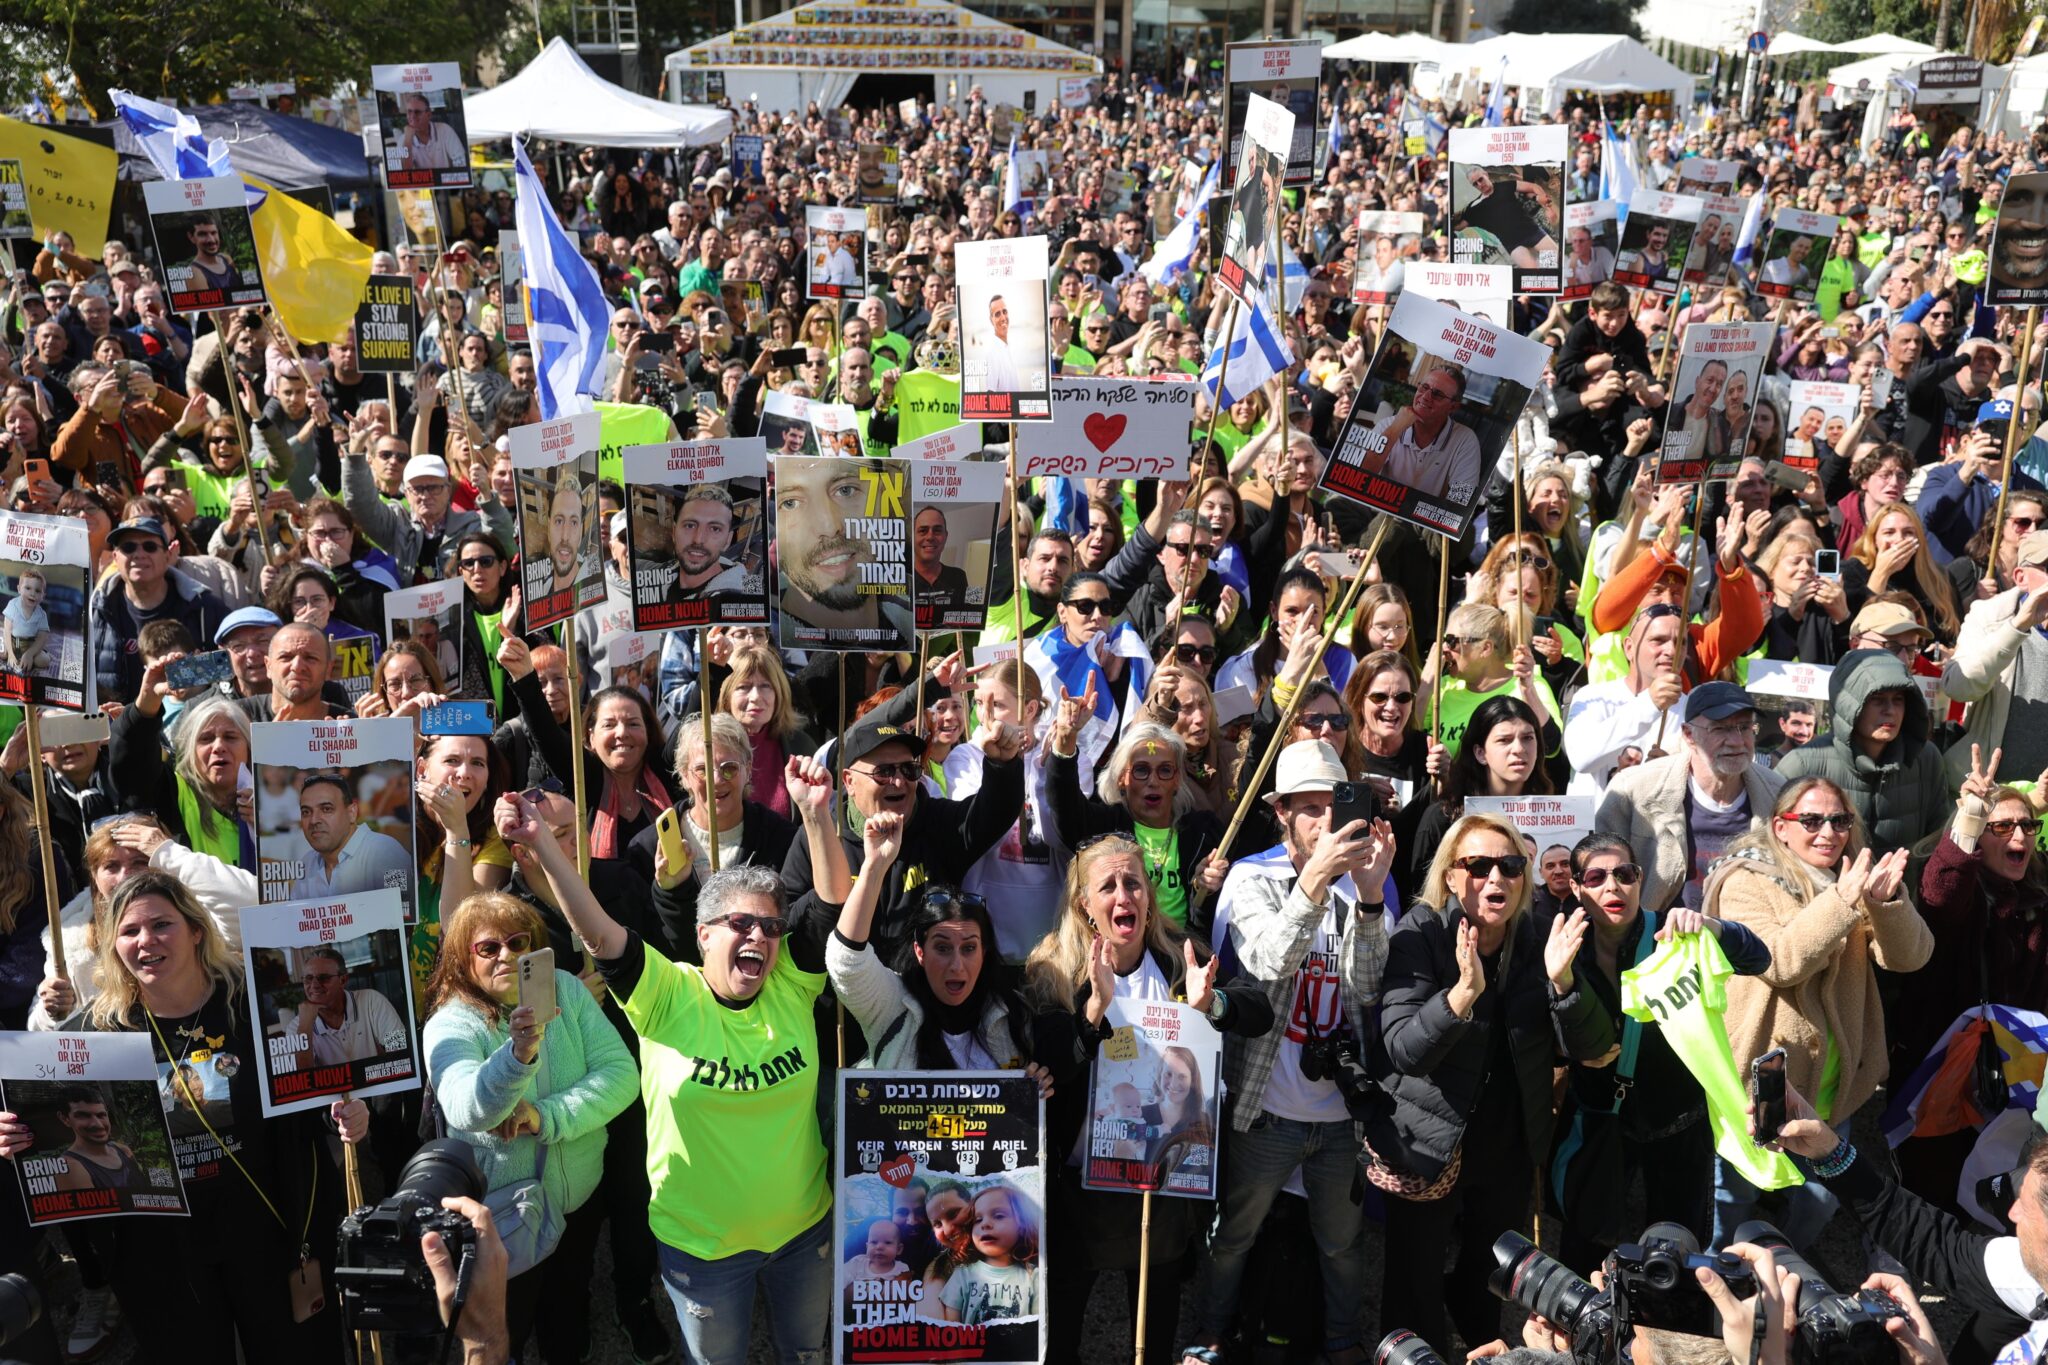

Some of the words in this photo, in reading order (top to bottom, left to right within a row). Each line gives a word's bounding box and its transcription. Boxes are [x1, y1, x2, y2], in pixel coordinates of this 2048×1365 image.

[1277, 58, 1291, 67] BIBAS
[1491, 133, 1502, 142] עמי
[1503, 134, 1510, 143] בן
[1487, 143, 1503, 153] OHAD
[1501, 153, 1514, 163] (55)
[1453, 237, 1484, 254] BRING
[1453, 253, 1473, 264] HIM
[167, 267, 193, 280] BRING
[1476, 272, 1490, 286] אלי
[173, 291, 198, 306] HOME
[373, 286, 405, 304] LOVE
[404, 288, 411, 305] U
[371, 304, 399, 322] STAY
[362, 322, 409, 341] STRONG!
[1467, 322, 1476, 337] בן
[1476, 325, 1498, 345] אוהד
[362, 340, 411, 359] SURVIVE!
[1441, 329, 1465, 349] OHAD
[1464, 335, 1481, 352] BEN
[1479, 342, 1497, 359] AMI
[1695, 341, 1703, 352] ELI
[1453, 347, 1472, 364] (55)
[964, 394, 988, 411] HOME
[989, 392, 1012, 411] NOW!
[1052, 387, 1091, 402] הרבה
[1096, 384, 1138, 407] שלקח
[1145, 387, 1188, 404] סליחה
[910, 398, 925, 413] לבד
[927, 398, 940, 413] לא
[1347, 426, 1388, 454] BRING
[1664, 431, 1692, 446] BRING
[671, 447, 696, 459] בוחבוט
[697, 445, 720, 458] אלקנה
[1337, 443, 1366, 468] HIM
[1664, 446, 1687, 461] THEM
[667, 456, 696, 471] ELKANA
[697, 456, 725, 469] BOHBOT
[1026, 455, 1088, 475] השבים
[1098, 455, 1175, 475] ברוכים
[1685, 459, 1707, 475] NOW!
[689, 470, 705, 482] (34)
[922, 476, 945, 487] TSACHI
[945, 476, 962, 487] IDAN
[860, 466, 905, 518] אל
[923, 487, 943, 499] (50)
[1329, 464, 1370, 491] HOME
[1369, 478, 1408, 508] NOW!
[8, 523, 26, 536] ביבס
[844, 518, 906, 541] תשאירו
[1439, 515, 1461, 530] FORUM
[27, 526, 46, 539] אריאל
[6, 534, 25, 548] ARIEL
[25, 537, 46, 550] BIBAS
[871, 540, 906, 563] אותי
[526, 557, 551, 582] BRING
[857, 562, 906, 584] מאחור
[636, 569, 673, 588] BRING
[527, 581, 544, 602] HIM
[637, 587, 661, 605] HIM
[856, 584, 882, 596] בוחבוט
[528, 595, 551, 622] HOME
[551, 588, 576, 612] NOW!
[638, 602, 672, 623] HOME
[675, 598, 710, 618] NOW!
[916, 604, 934, 623] W!
[335, 644, 370, 678] אל
[311, 726, 338, 738] שרעבי
[340, 725, 353, 738] אלי
[308, 740, 321, 752] ELI
[322, 738, 358, 752] SHARABI
[326, 752, 342, 766] (51)
[1501, 802, 1527, 813] שרעבי
[1528, 801, 1547, 813] ויוסי
[1548, 801, 1562, 812] אלי
[1516, 815, 1539, 826] YOSSI
[1540, 814, 1576, 826] SHARABI
[262, 860, 306, 882] BRING
[262, 881, 291, 902] HIM
[302, 907, 318, 920] עמי
[328, 903, 348, 917] אוהד
[298, 918, 321, 933] OHAD
[321, 917, 338, 930] BEN
[339, 914, 354, 927] AMI
[319, 929, 337, 943] (55)
[1644, 994, 1669, 1027] ל
[1142, 1018, 1160, 1029] SHIRI
[1161, 1019, 1181, 1030] BIBAS
[59, 1038, 70, 1049] לוי
[75, 1038, 87, 1049] אור
[268, 1032, 310, 1057] BRING
[58, 1052, 69, 1063] OR
[71, 1051, 90, 1062] LEVY
[34, 1063, 56, 1079] 34
[271, 1055, 298, 1076] HIM
[690, 1055, 732, 1090] לבד
[760, 1045, 808, 1087] אתם
[274, 1071, 312, 1098] HOME
[313, 1062, 354, 1090] NOW!
[733, 1063, 760, 1092] לא
[885, 1083, 928, 1100] ביבס
[931, 1082, 1001, 1100] משפחת
[879, 1103, 924, 1116] החמאס
[926, 1103, 956, 1115] בשבי
[957, 1102, 1007, 1116] מוחזקים
[928, 1117, 962, 1137] 491
[1093, 1120, 1128, 1141] BRING
[225, 1134, 233, 1144] IS
[894, 1140, 943, 1151] YARDEN
[951, 1140, 986, 1151] SHIRI
[992, 1139, 1029, 1151] ARIEL
[1091, 1138, 1115, 1158] HER
[956, 1150, 981, 1166] (33)
[22, 1157, 69, 1178] BRING
[1090, 1161, 1122, 1179] HOME
[1126, 1163, 1160, 1181] NOW!
[27, 1176, 58, 1196] HIM
[1190, 1179, 1209, 1190] FORUM
[31, 1193, 73, 1215] HOME
[76, 1186, 120, 1208] NOW!
[852, 1279, 925, 1302] BRING
[852, 1303, 917, 1326] THEM
[852, 1325, 920, 1350] HOME
[924, 1323, 987, 1347] NOW!
